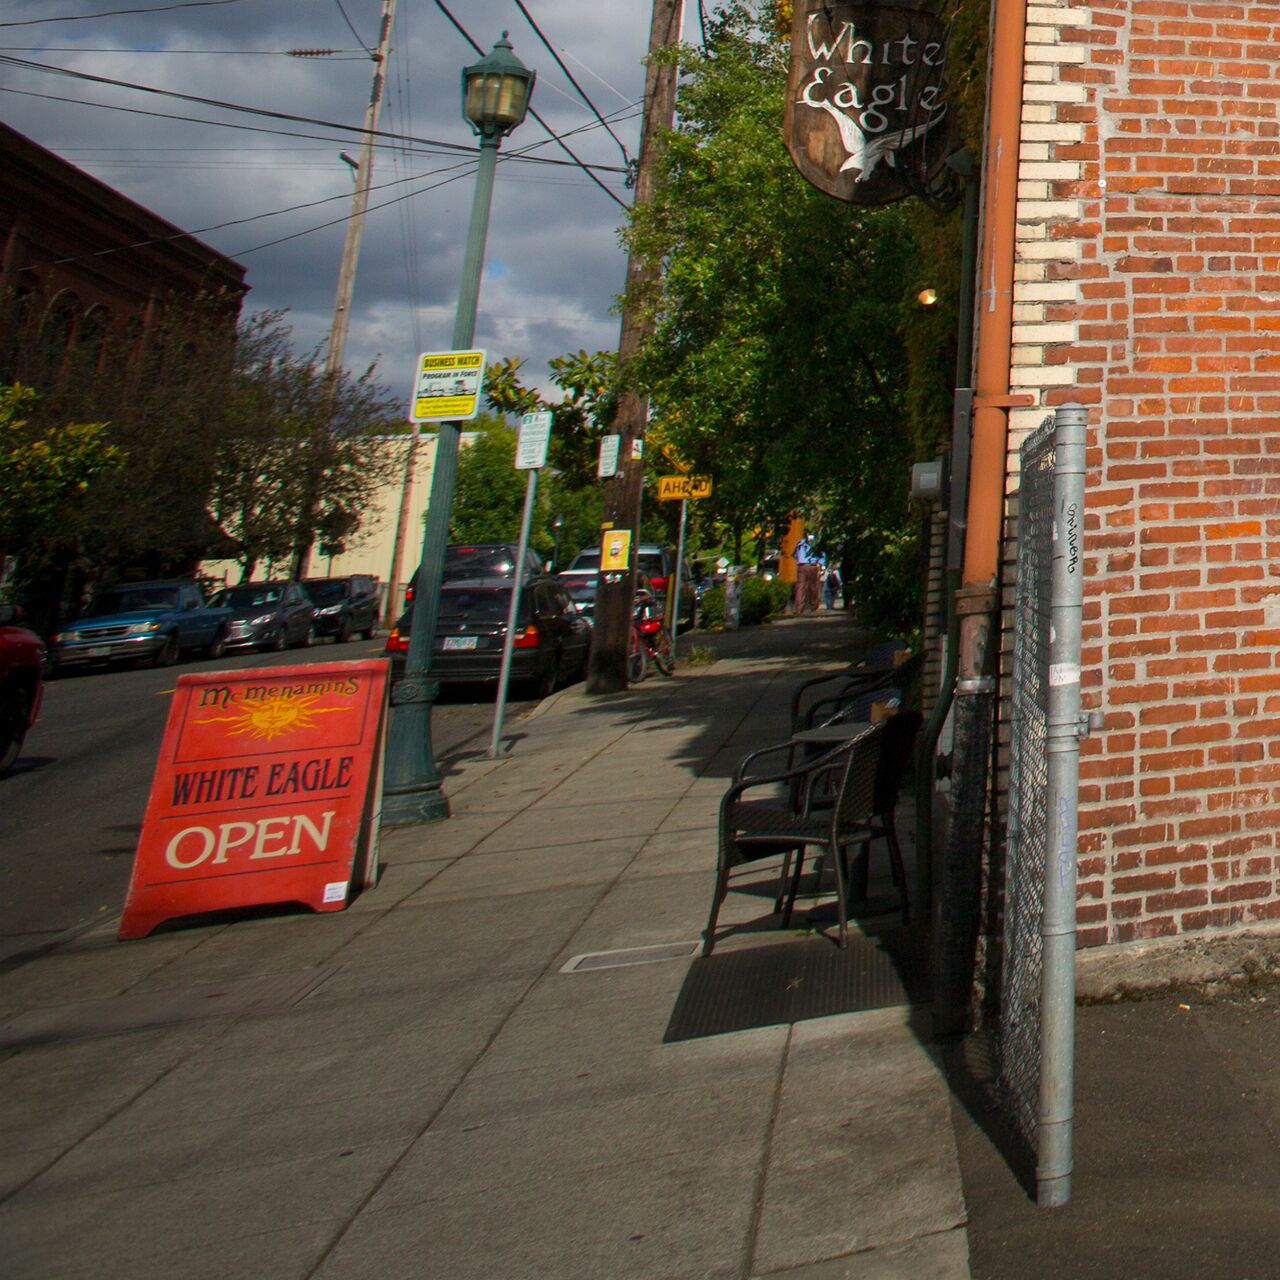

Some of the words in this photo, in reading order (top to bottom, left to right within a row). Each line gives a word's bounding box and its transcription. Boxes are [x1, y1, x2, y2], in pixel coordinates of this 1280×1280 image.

[807, 13, 946, 66] White
[802, 66, 947, 133] Eagle
[424, 357, 456, 368] BUSINESS
[171, 766, 260, 807] WHITE
[265, 757, 354, 796] EAGLE
[166, 811, 336, 869] OPEN
